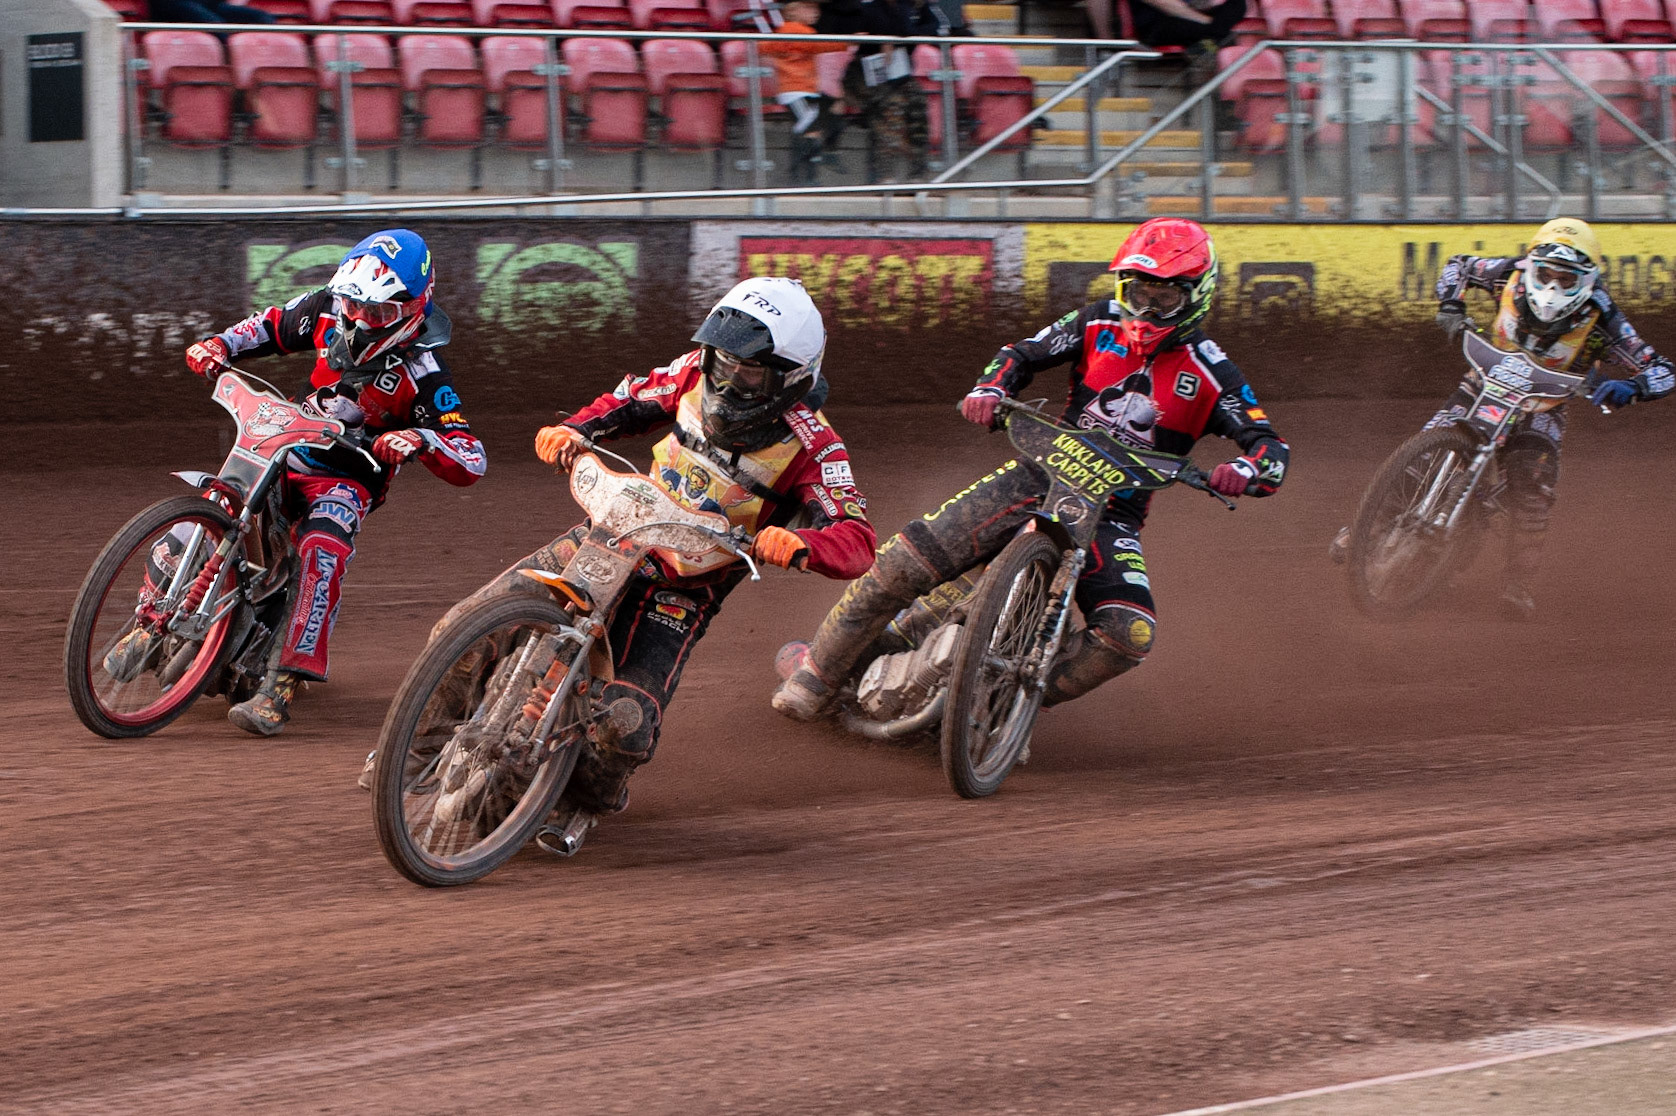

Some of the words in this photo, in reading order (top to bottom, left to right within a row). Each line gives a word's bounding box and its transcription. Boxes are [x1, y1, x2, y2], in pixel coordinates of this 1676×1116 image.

[379, 374, 395, 390] 6
[1177, 375, 1194, 395] 5
[383, 433, 416, 457] FOX
[1051, 433, 1126, 486] KIRKLAND
[1046, 452, 1110, 496] CARPETS
